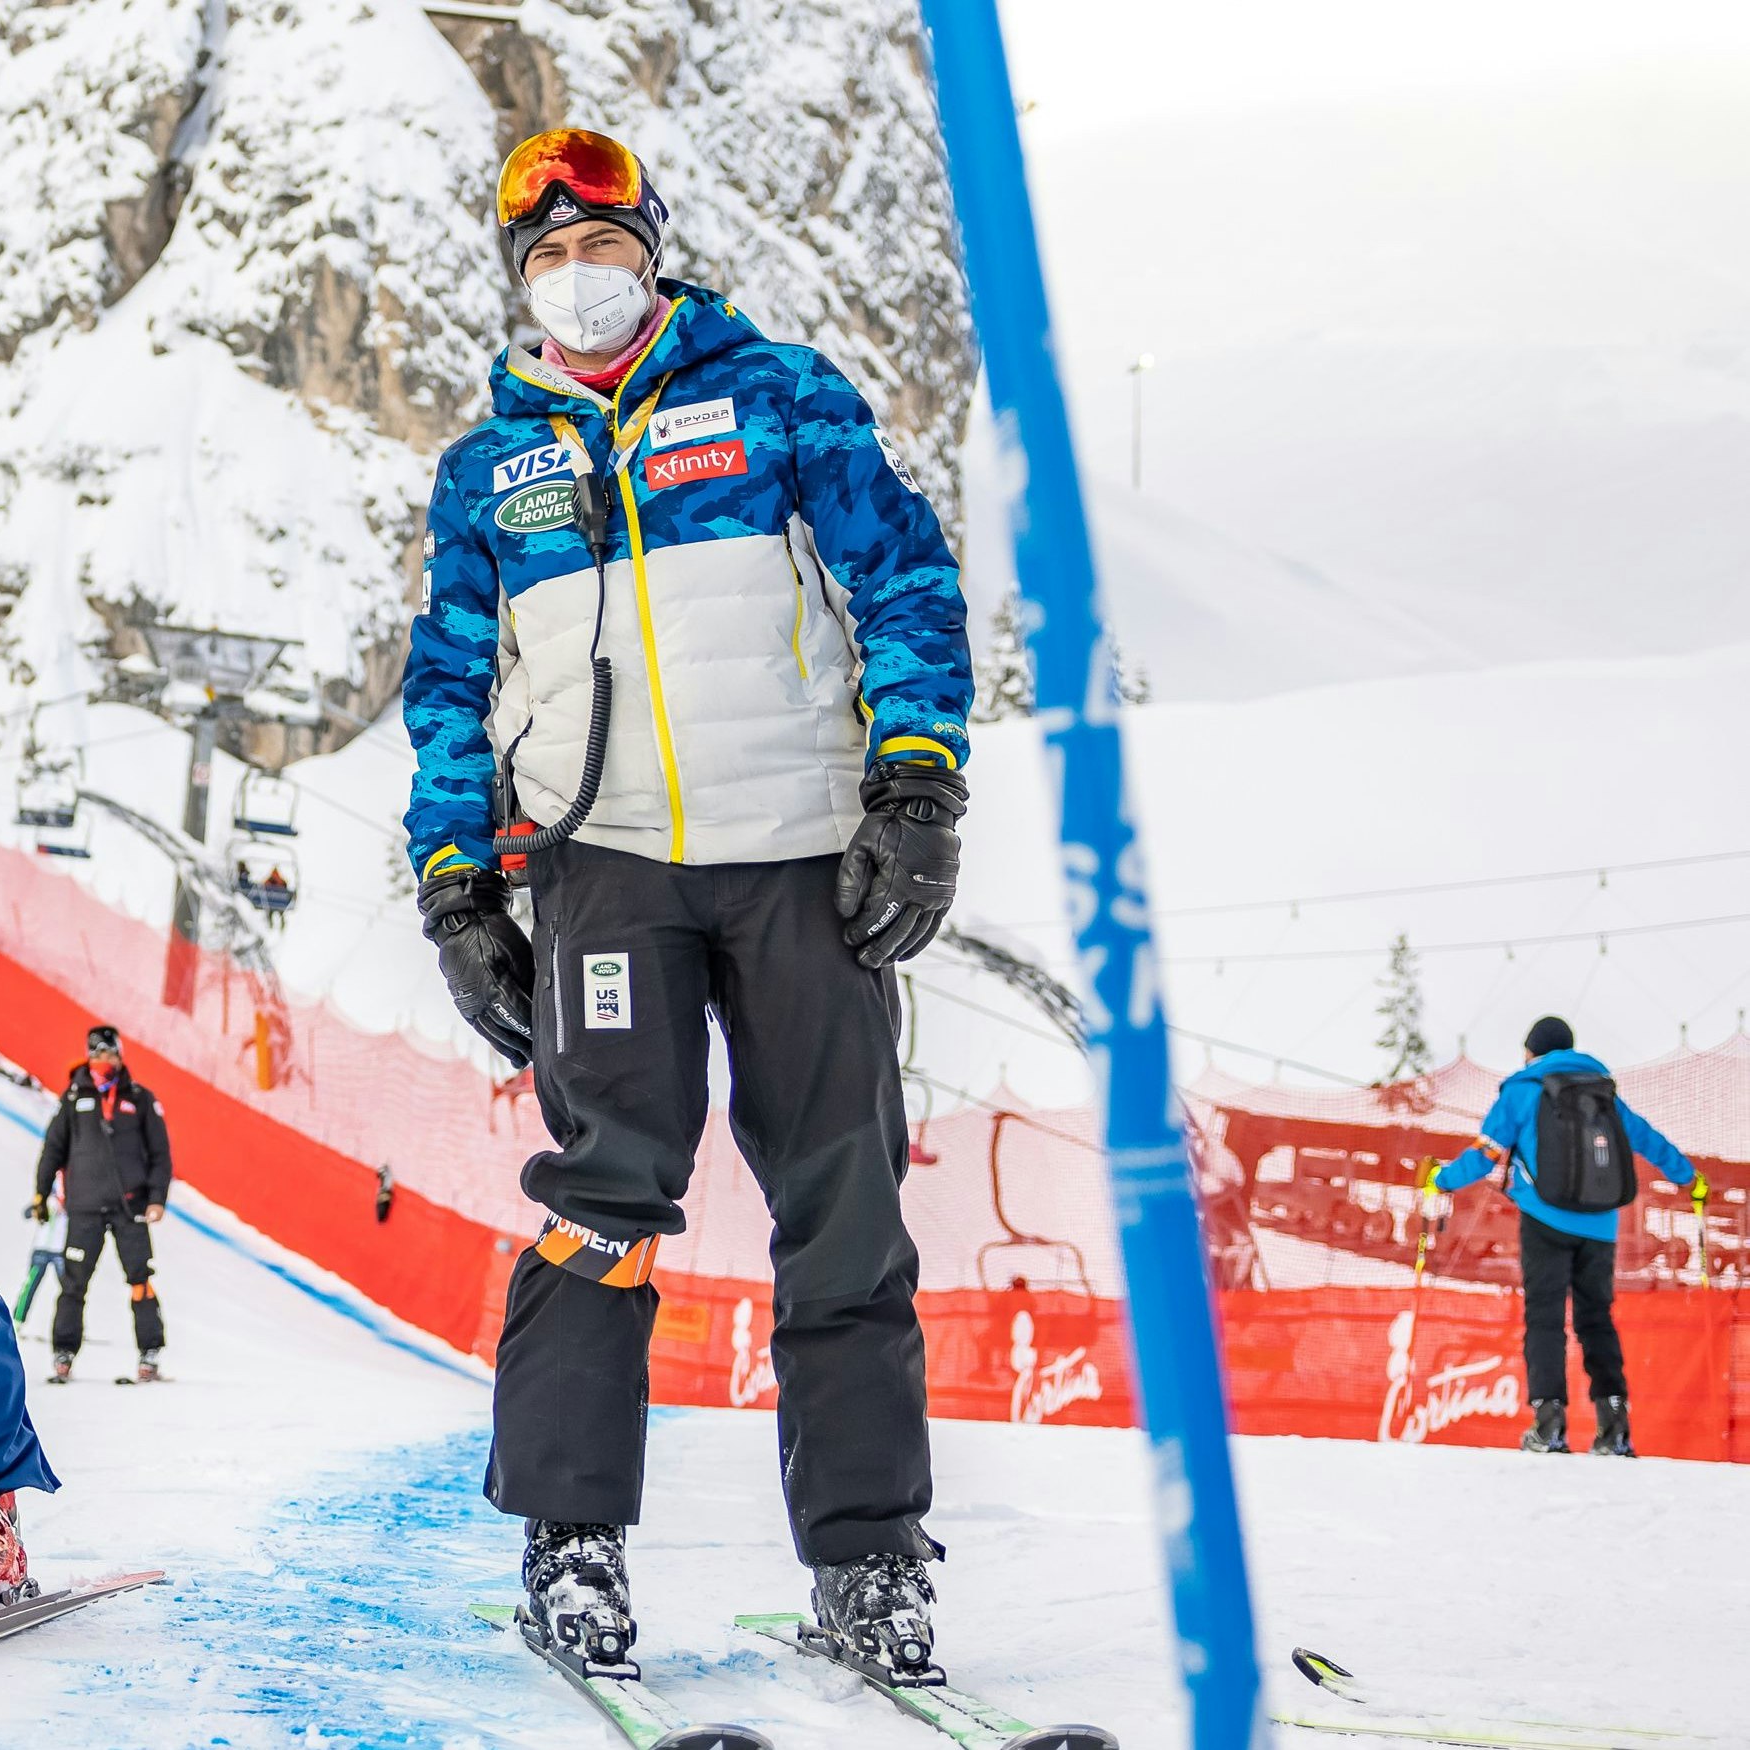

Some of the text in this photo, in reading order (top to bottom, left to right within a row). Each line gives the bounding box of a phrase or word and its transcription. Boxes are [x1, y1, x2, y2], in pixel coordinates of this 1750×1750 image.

[674, 409, 730, 427] SPYDER
[653, 449, 737, 481] xfinity
[515, 491, 559, 514] LAND
[520, 500, 574, 525] ROVER
[867, 901, 899, 936] reusch
[596, 989, 619, 1000] US
[493, 1002, 531, 1035] reusch
[1378, 1345, 1521, 1443] Cortina
